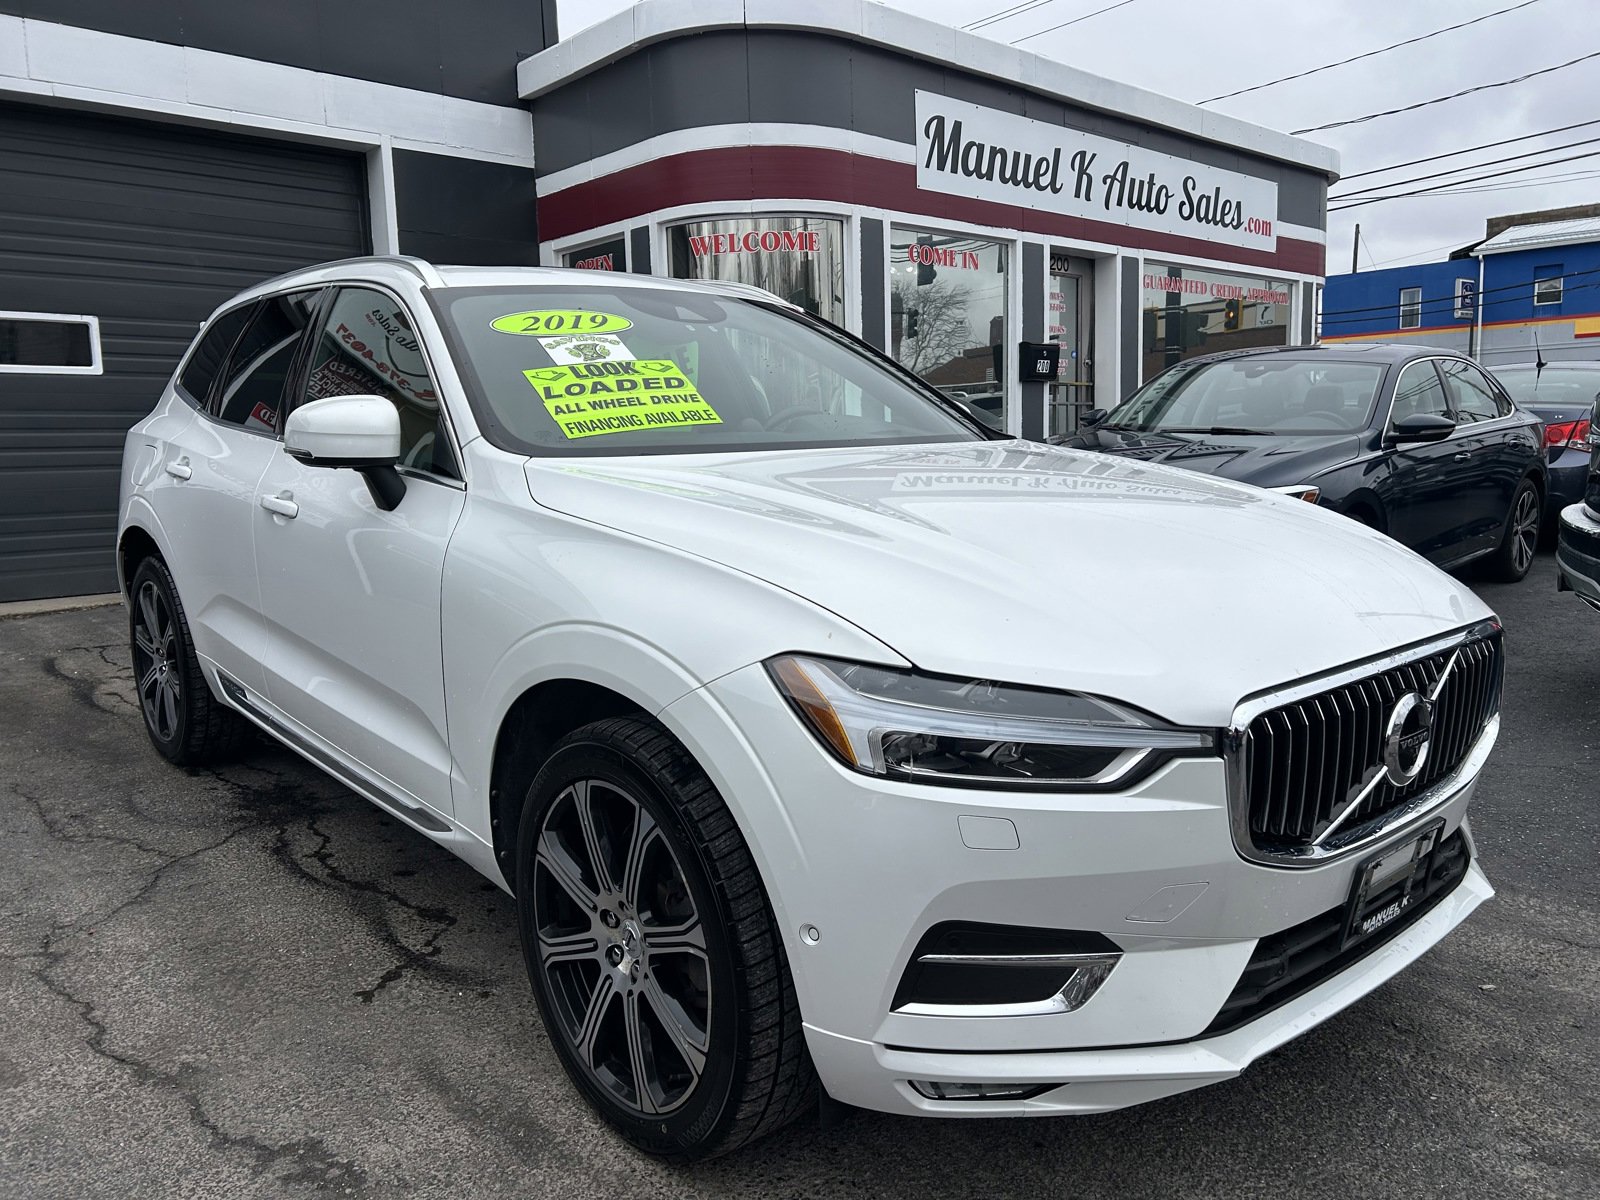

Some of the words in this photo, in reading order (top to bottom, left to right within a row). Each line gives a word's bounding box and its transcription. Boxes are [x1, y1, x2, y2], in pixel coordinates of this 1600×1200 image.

[924, 114, 1062, 194] Manuel
[1070, 150, 1098, 202] K
[1102, 160, 1174, 210] Auto
[689, 230, 821, 258] WELCOME
[908, 243, 957, 268] COME
[961, 251, 979, 270] IN
[1050, 256, 1070, 272] 200
[1143, 274, 1207, 295] GUARANTEED
[1210, 283, 1243, 300] CREDIT
[520, 314, 609, 332] 2019
[568, 361, 642, 380] LOOK
[1037, 360, 1050, 373] 200
[543, 376, 687, 400] LOADED
[554, 404, 586, 416] ALL
[588, 396, 647, 412] WHEEL
[652, 393, 700, 405] DRIVE
[565, 414, 642, 435] FINANCING
[647, 409, 717, 425] AVAILABLE
[1399, 731, 1429, 750] VOLVO
[1363, 902, 1399, 930] MANUEL
